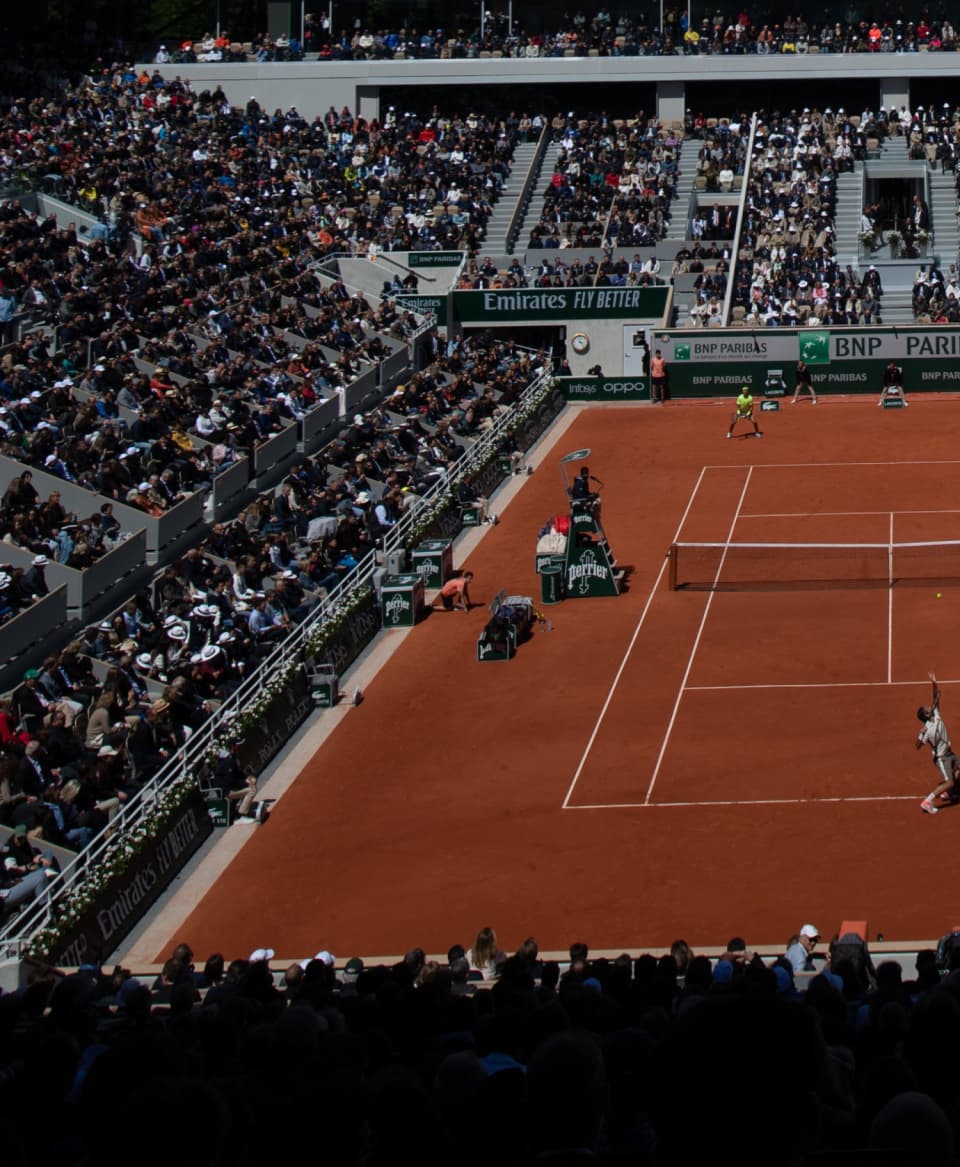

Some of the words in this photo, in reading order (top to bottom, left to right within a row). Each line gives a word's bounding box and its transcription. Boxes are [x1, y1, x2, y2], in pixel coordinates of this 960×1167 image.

[484, 292, 567, 310] Emirates
[574, 292, 595, 309] FLY
[597, 290, 641, 308] BETTER
[694, 343, 717, 354] BNP
[721, 342, 768, 353] PARIBAS
[836, 337, 882, 357] BNP
[693, 376, 711, 384] BNP
[714, 375, 752, 384] PARIBAS
[829, 373, 867, 381] PARIBAS
[922, 372, 940, 380] BNP
[603, 382, 645, 394] oppo
[96, 864, 157, 941] Emirates
